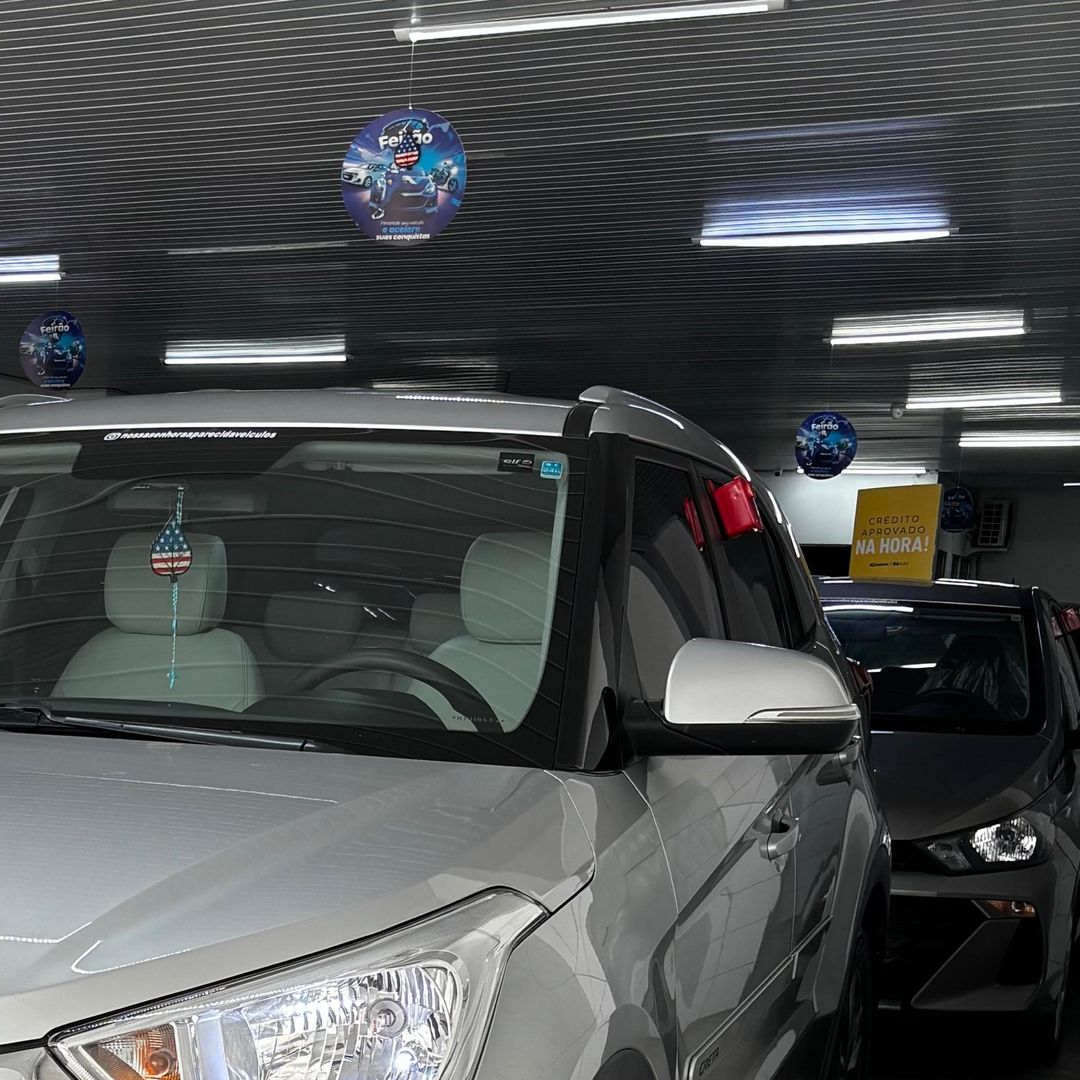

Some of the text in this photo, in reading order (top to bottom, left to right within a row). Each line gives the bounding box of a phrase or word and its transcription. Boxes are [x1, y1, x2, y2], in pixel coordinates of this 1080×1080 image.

[378, 129, 433, 149] Feião
[393, 233, 430, 241] conquistas
[40, 323, 70, 334] Feirão
[811, 421, 839, 431] Feirão
[868, 514, 920, 526] CRÉDITO
[861, 525, 926, 537] APROVADO
[855, 535, 929, 555] NA HORA!
